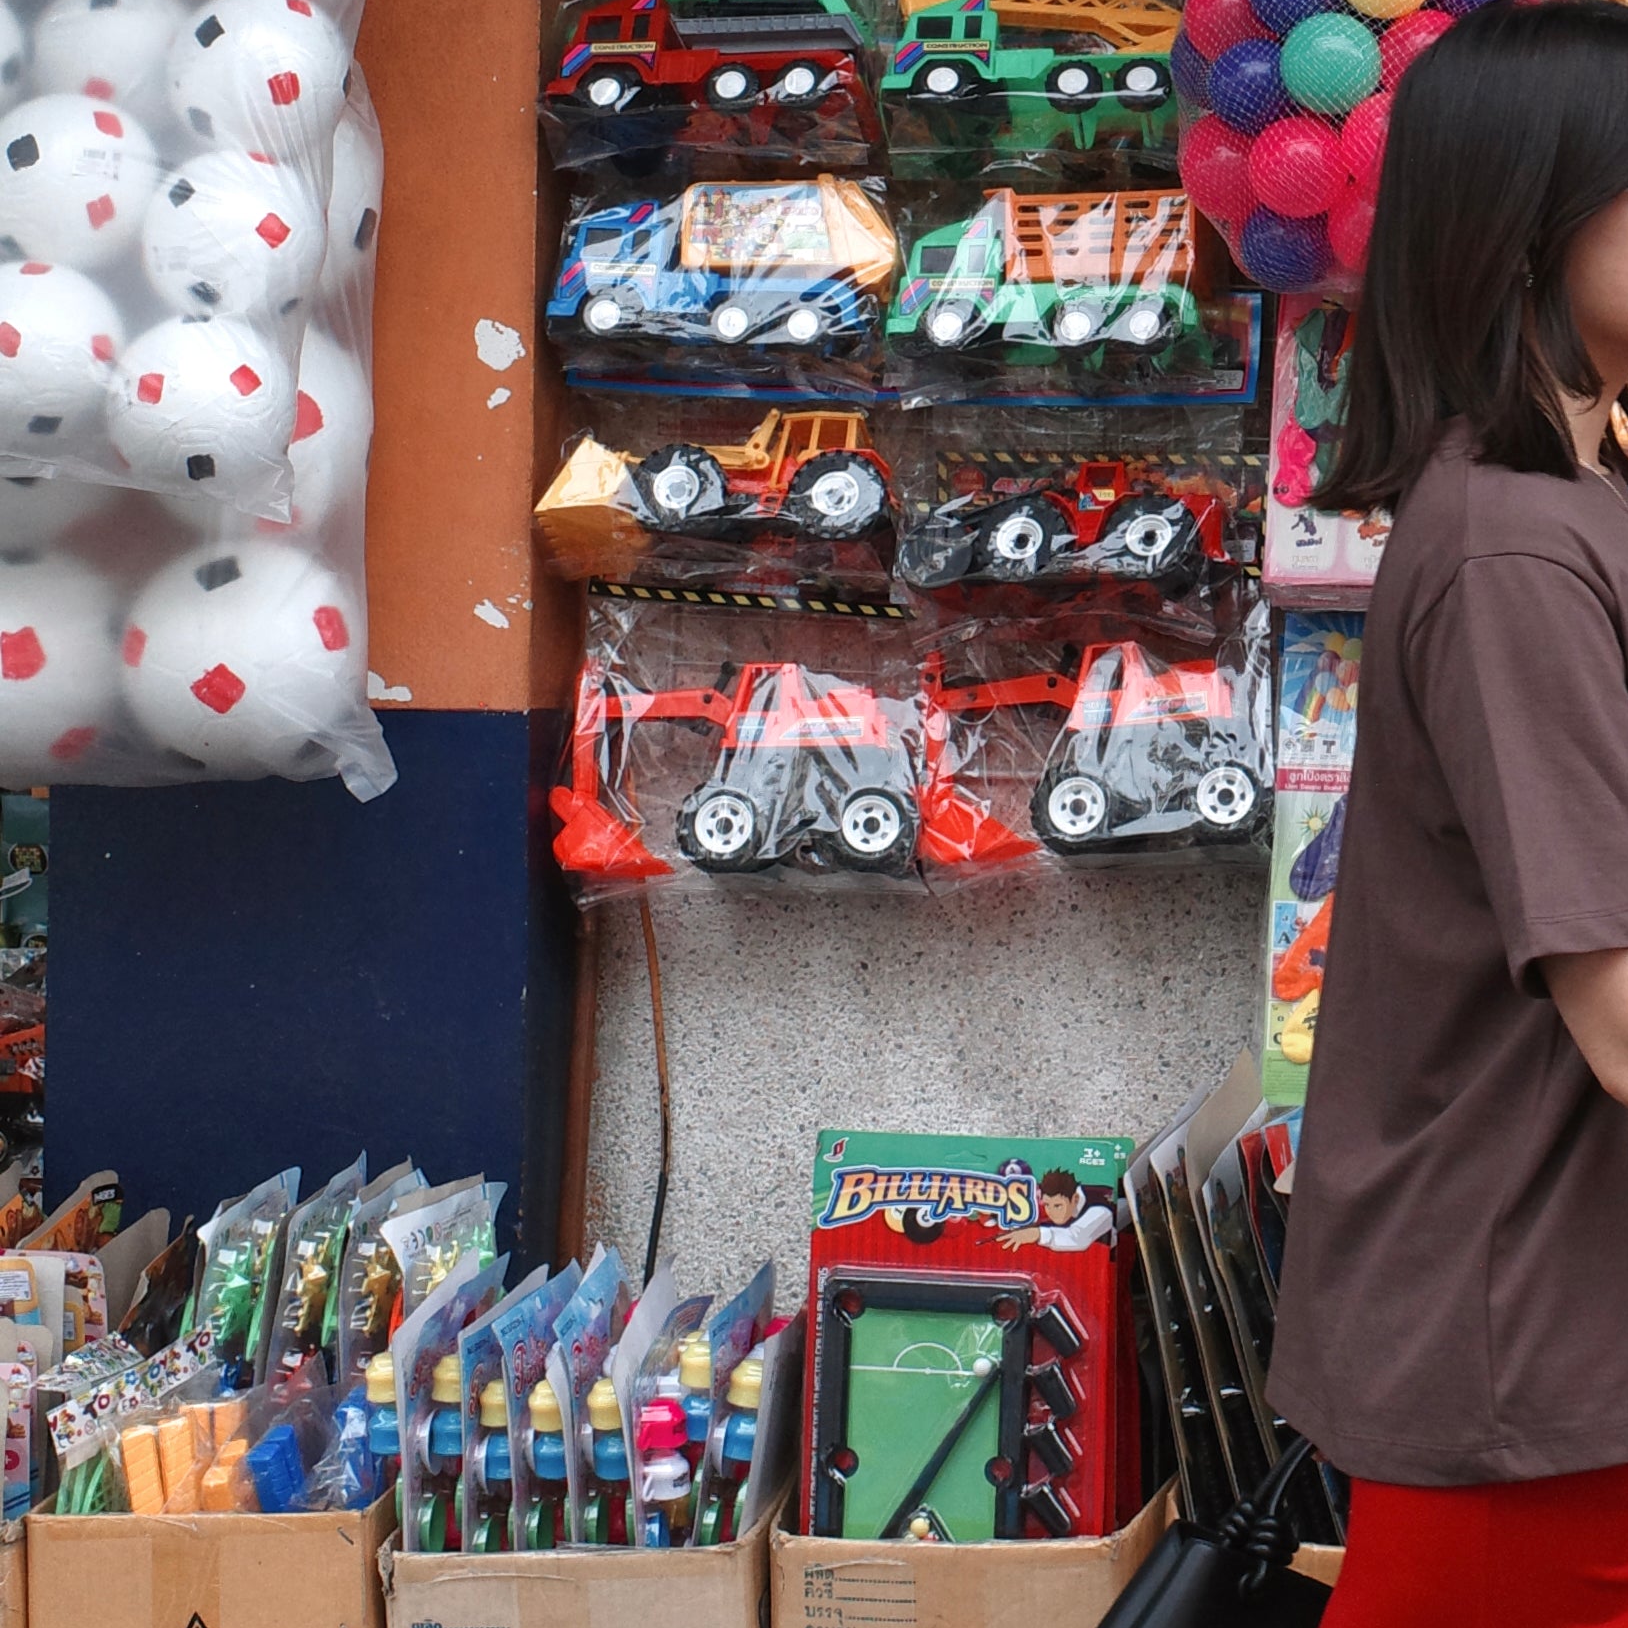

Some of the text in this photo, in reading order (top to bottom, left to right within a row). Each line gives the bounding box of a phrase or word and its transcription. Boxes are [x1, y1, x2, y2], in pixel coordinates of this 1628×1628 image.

[592, 43, 655, 52] CONSTRUCTION
[926, 42, 989, 51] CONSTRUCTION
[1084, 1149, 1101, 1158] 3+
[1079, 1157, 1105, 1166] AGES
[822, 1168, 1034, 1226] BILLIARDS
